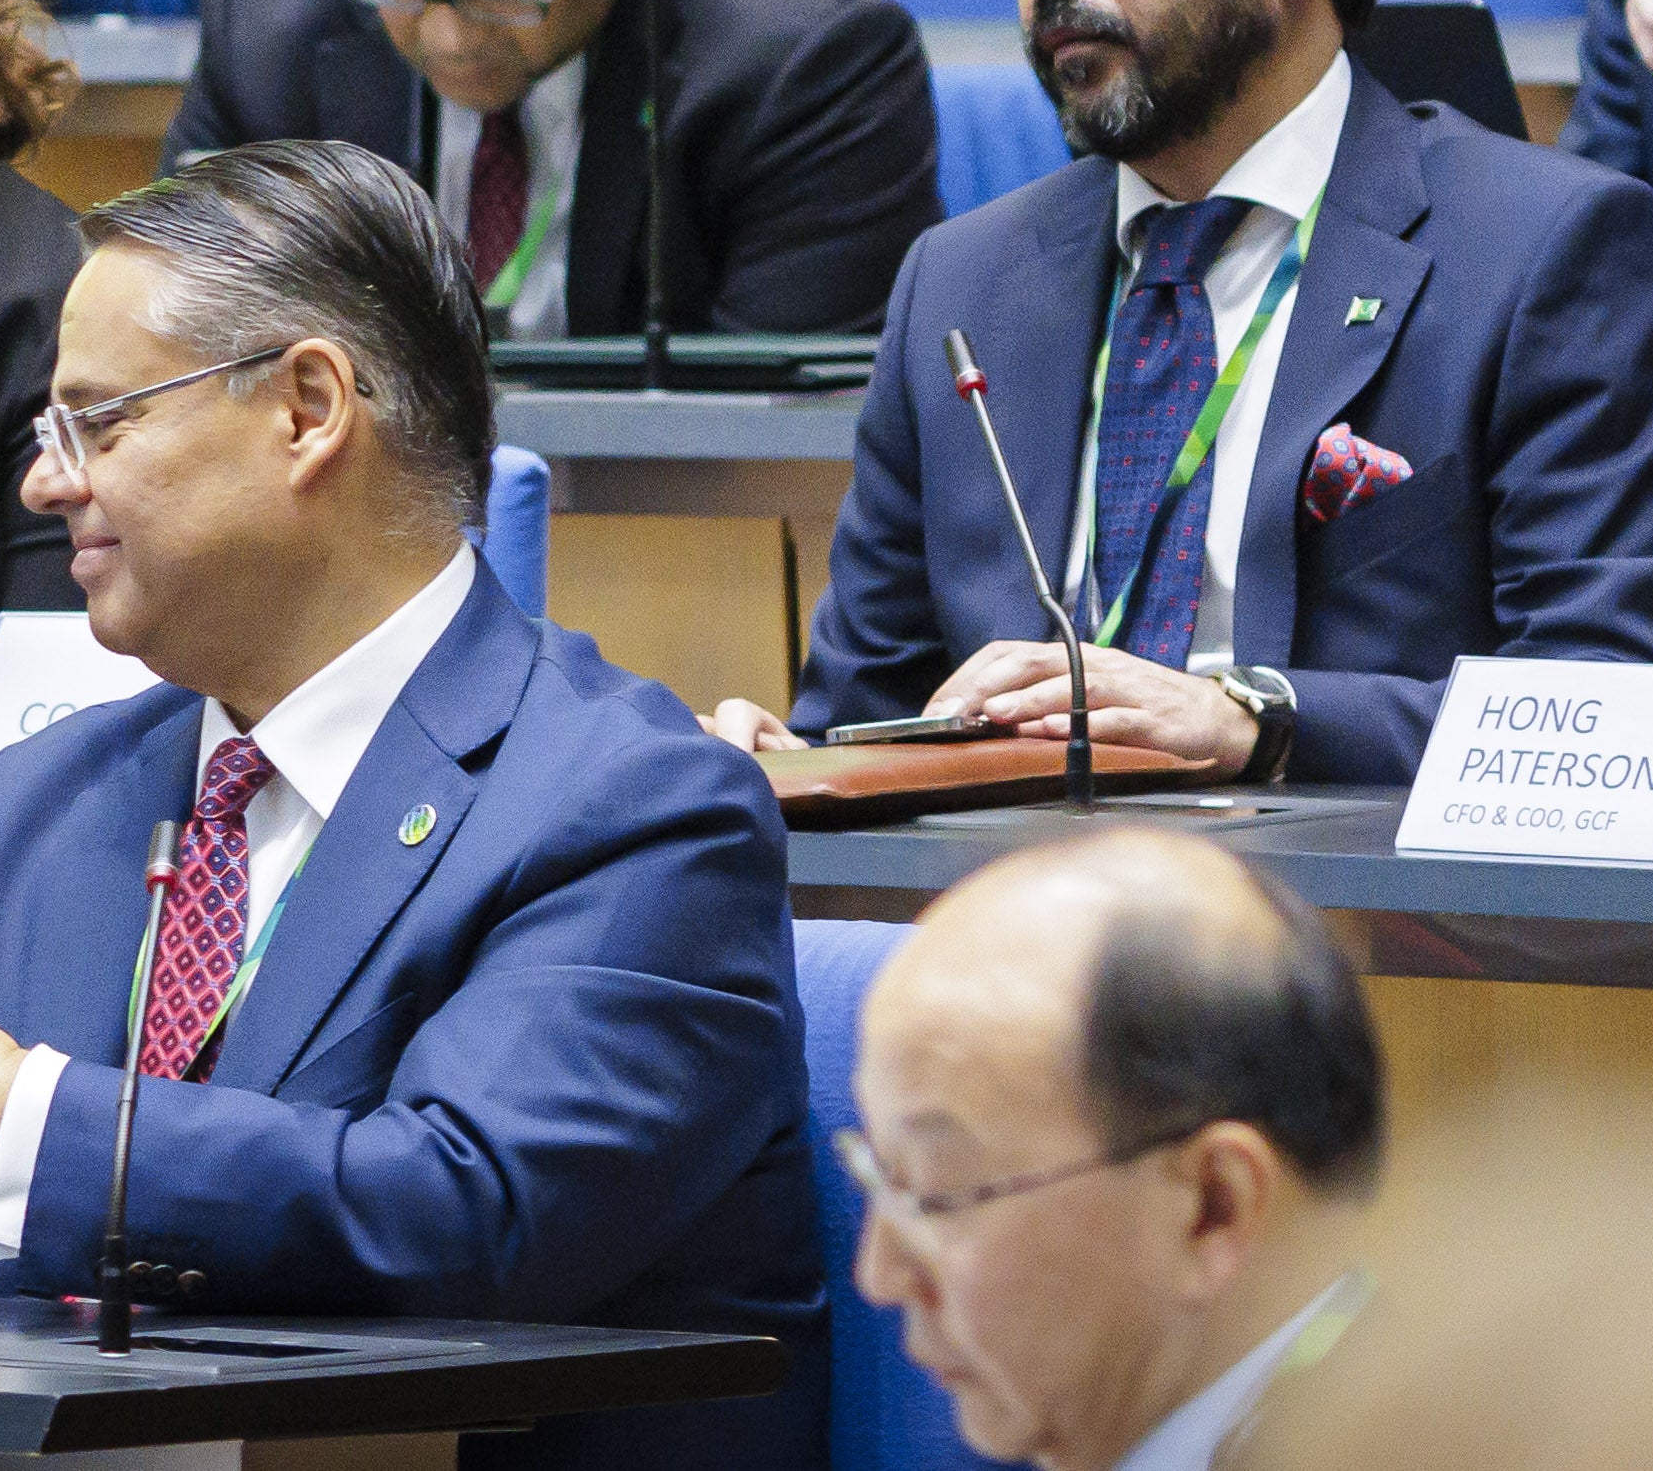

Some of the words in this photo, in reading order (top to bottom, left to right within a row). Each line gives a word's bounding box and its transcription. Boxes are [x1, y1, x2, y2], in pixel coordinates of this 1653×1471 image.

[1477, 695, 1603, 735] HONG
[1443, 803, 1486, 825] CFO
[1491, 805, 1507, 826] &
[1515, 807, 1566, 833] COO,
[1575, 809, 1619, 831] GCF
